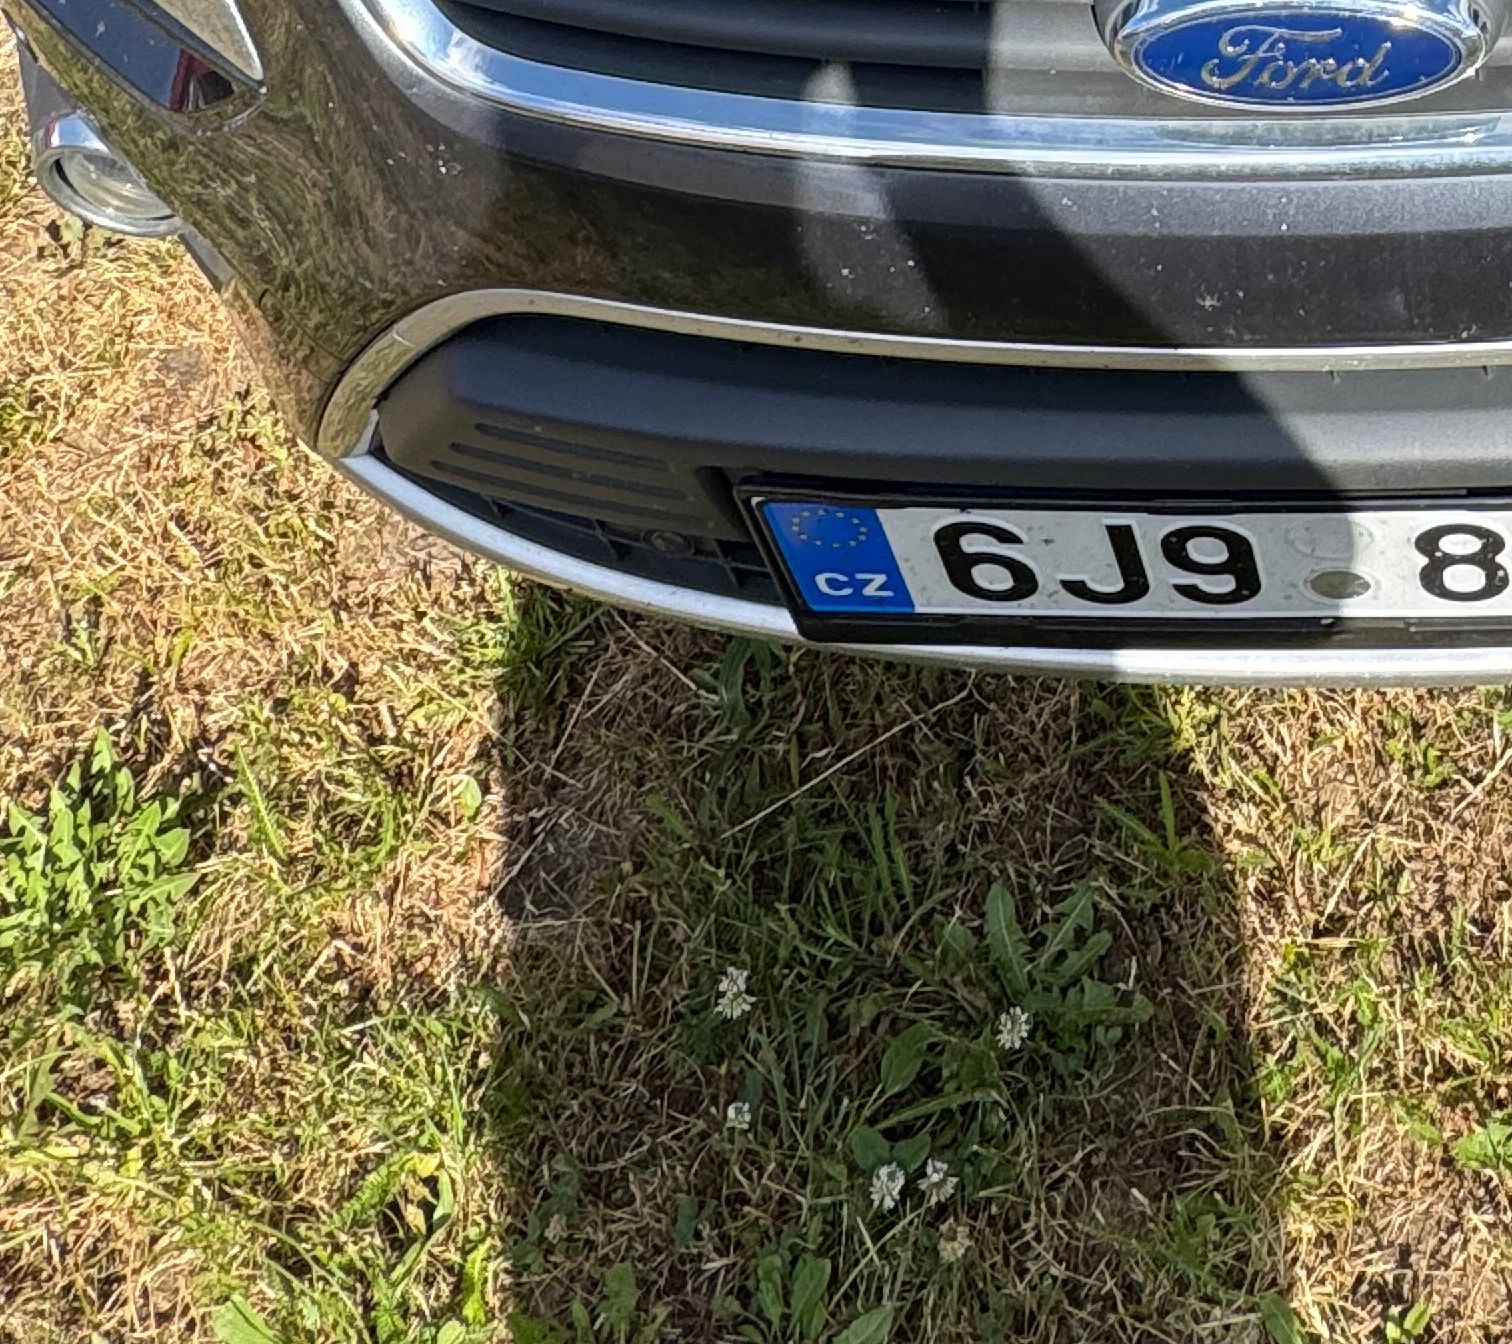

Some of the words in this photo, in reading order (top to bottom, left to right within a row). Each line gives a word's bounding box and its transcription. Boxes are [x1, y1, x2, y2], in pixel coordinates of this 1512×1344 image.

[1201, 24, 1392, 90] Ford
[815, 572, 893, 597] CZ
[933, 521, 1262, 605] 6J9
